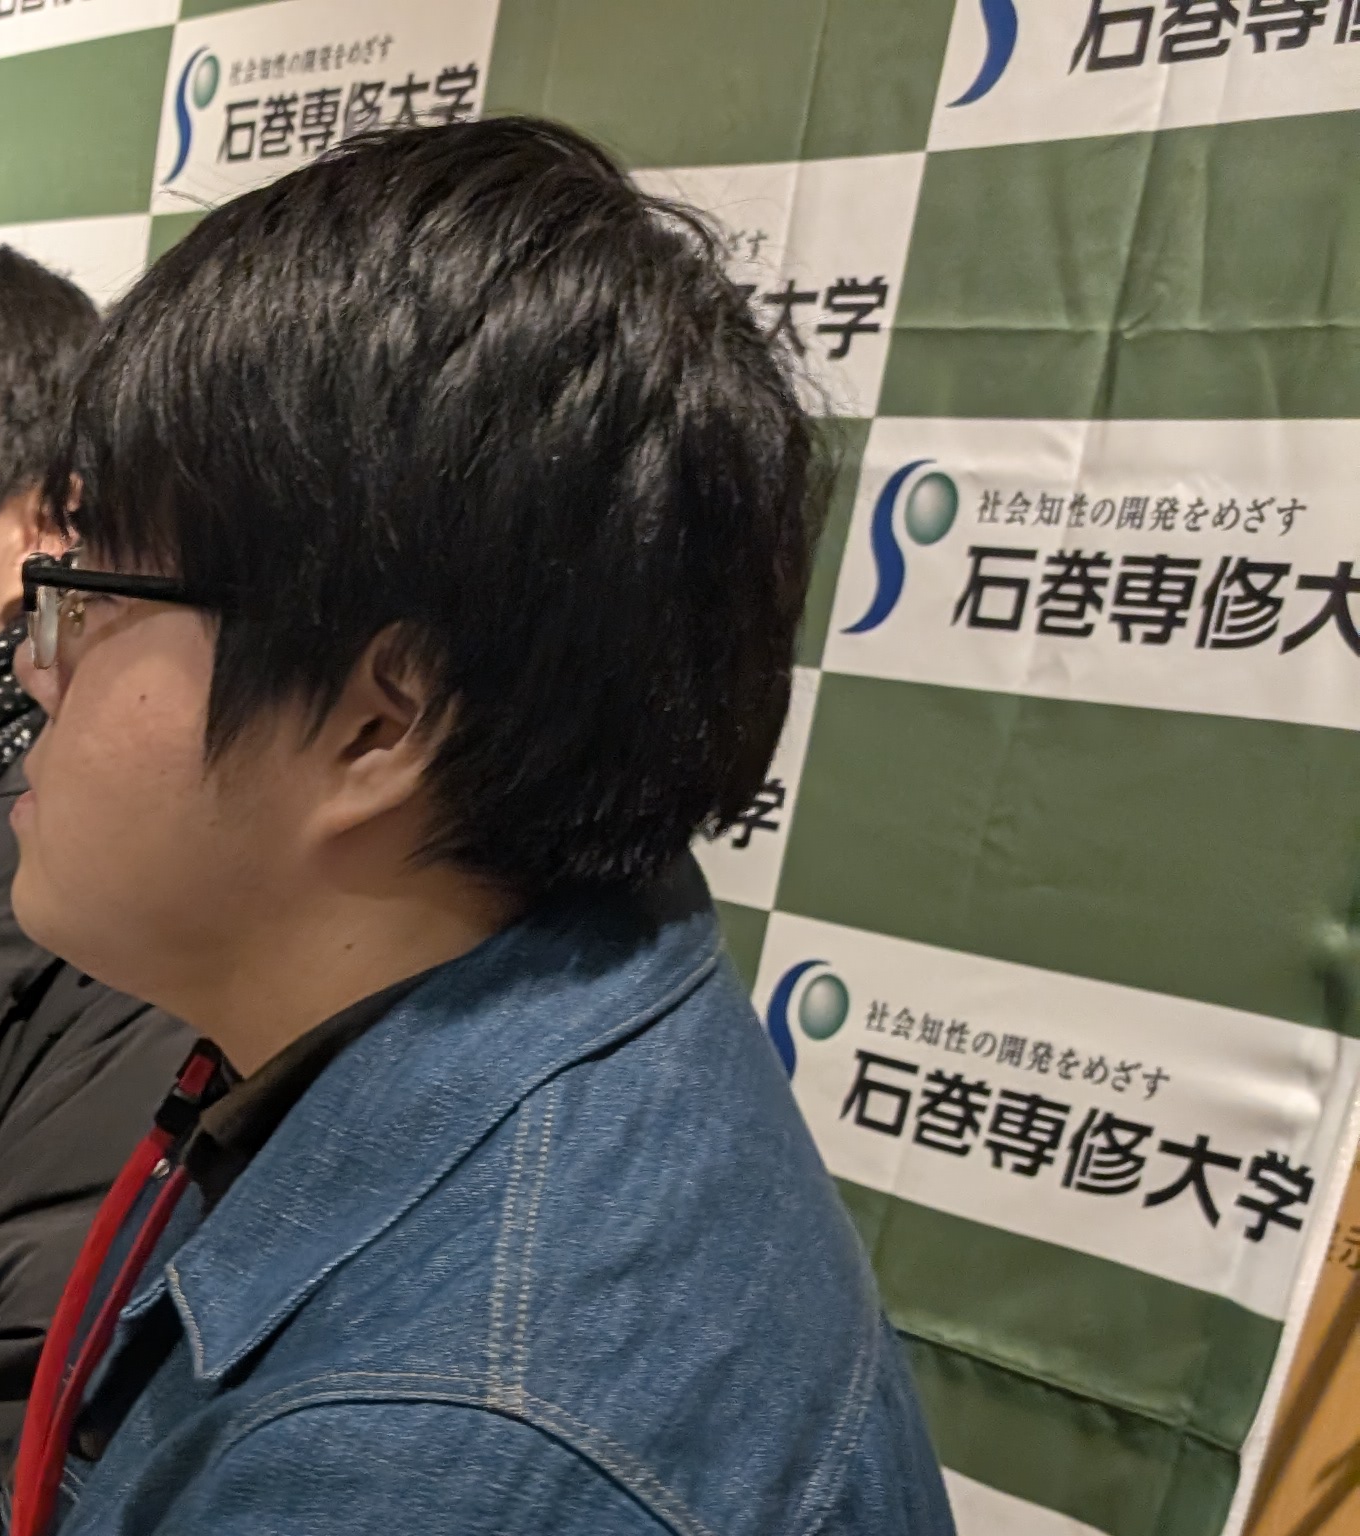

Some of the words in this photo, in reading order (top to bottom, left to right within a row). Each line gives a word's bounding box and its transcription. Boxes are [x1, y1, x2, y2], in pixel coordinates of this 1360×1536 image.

[1067, 0, 1360, 75] 石巻専
[216, 63, 479, 164] 石巻専修大学
[734, 275, 888, 358] 大学
[976, 490, 1308, 537] 社会知性の開発をめざす
[864, 1000, 1171, 1100] 社会知性の開発をめざす
[840, 1050, 1315, 1243] 石巻専修大学
